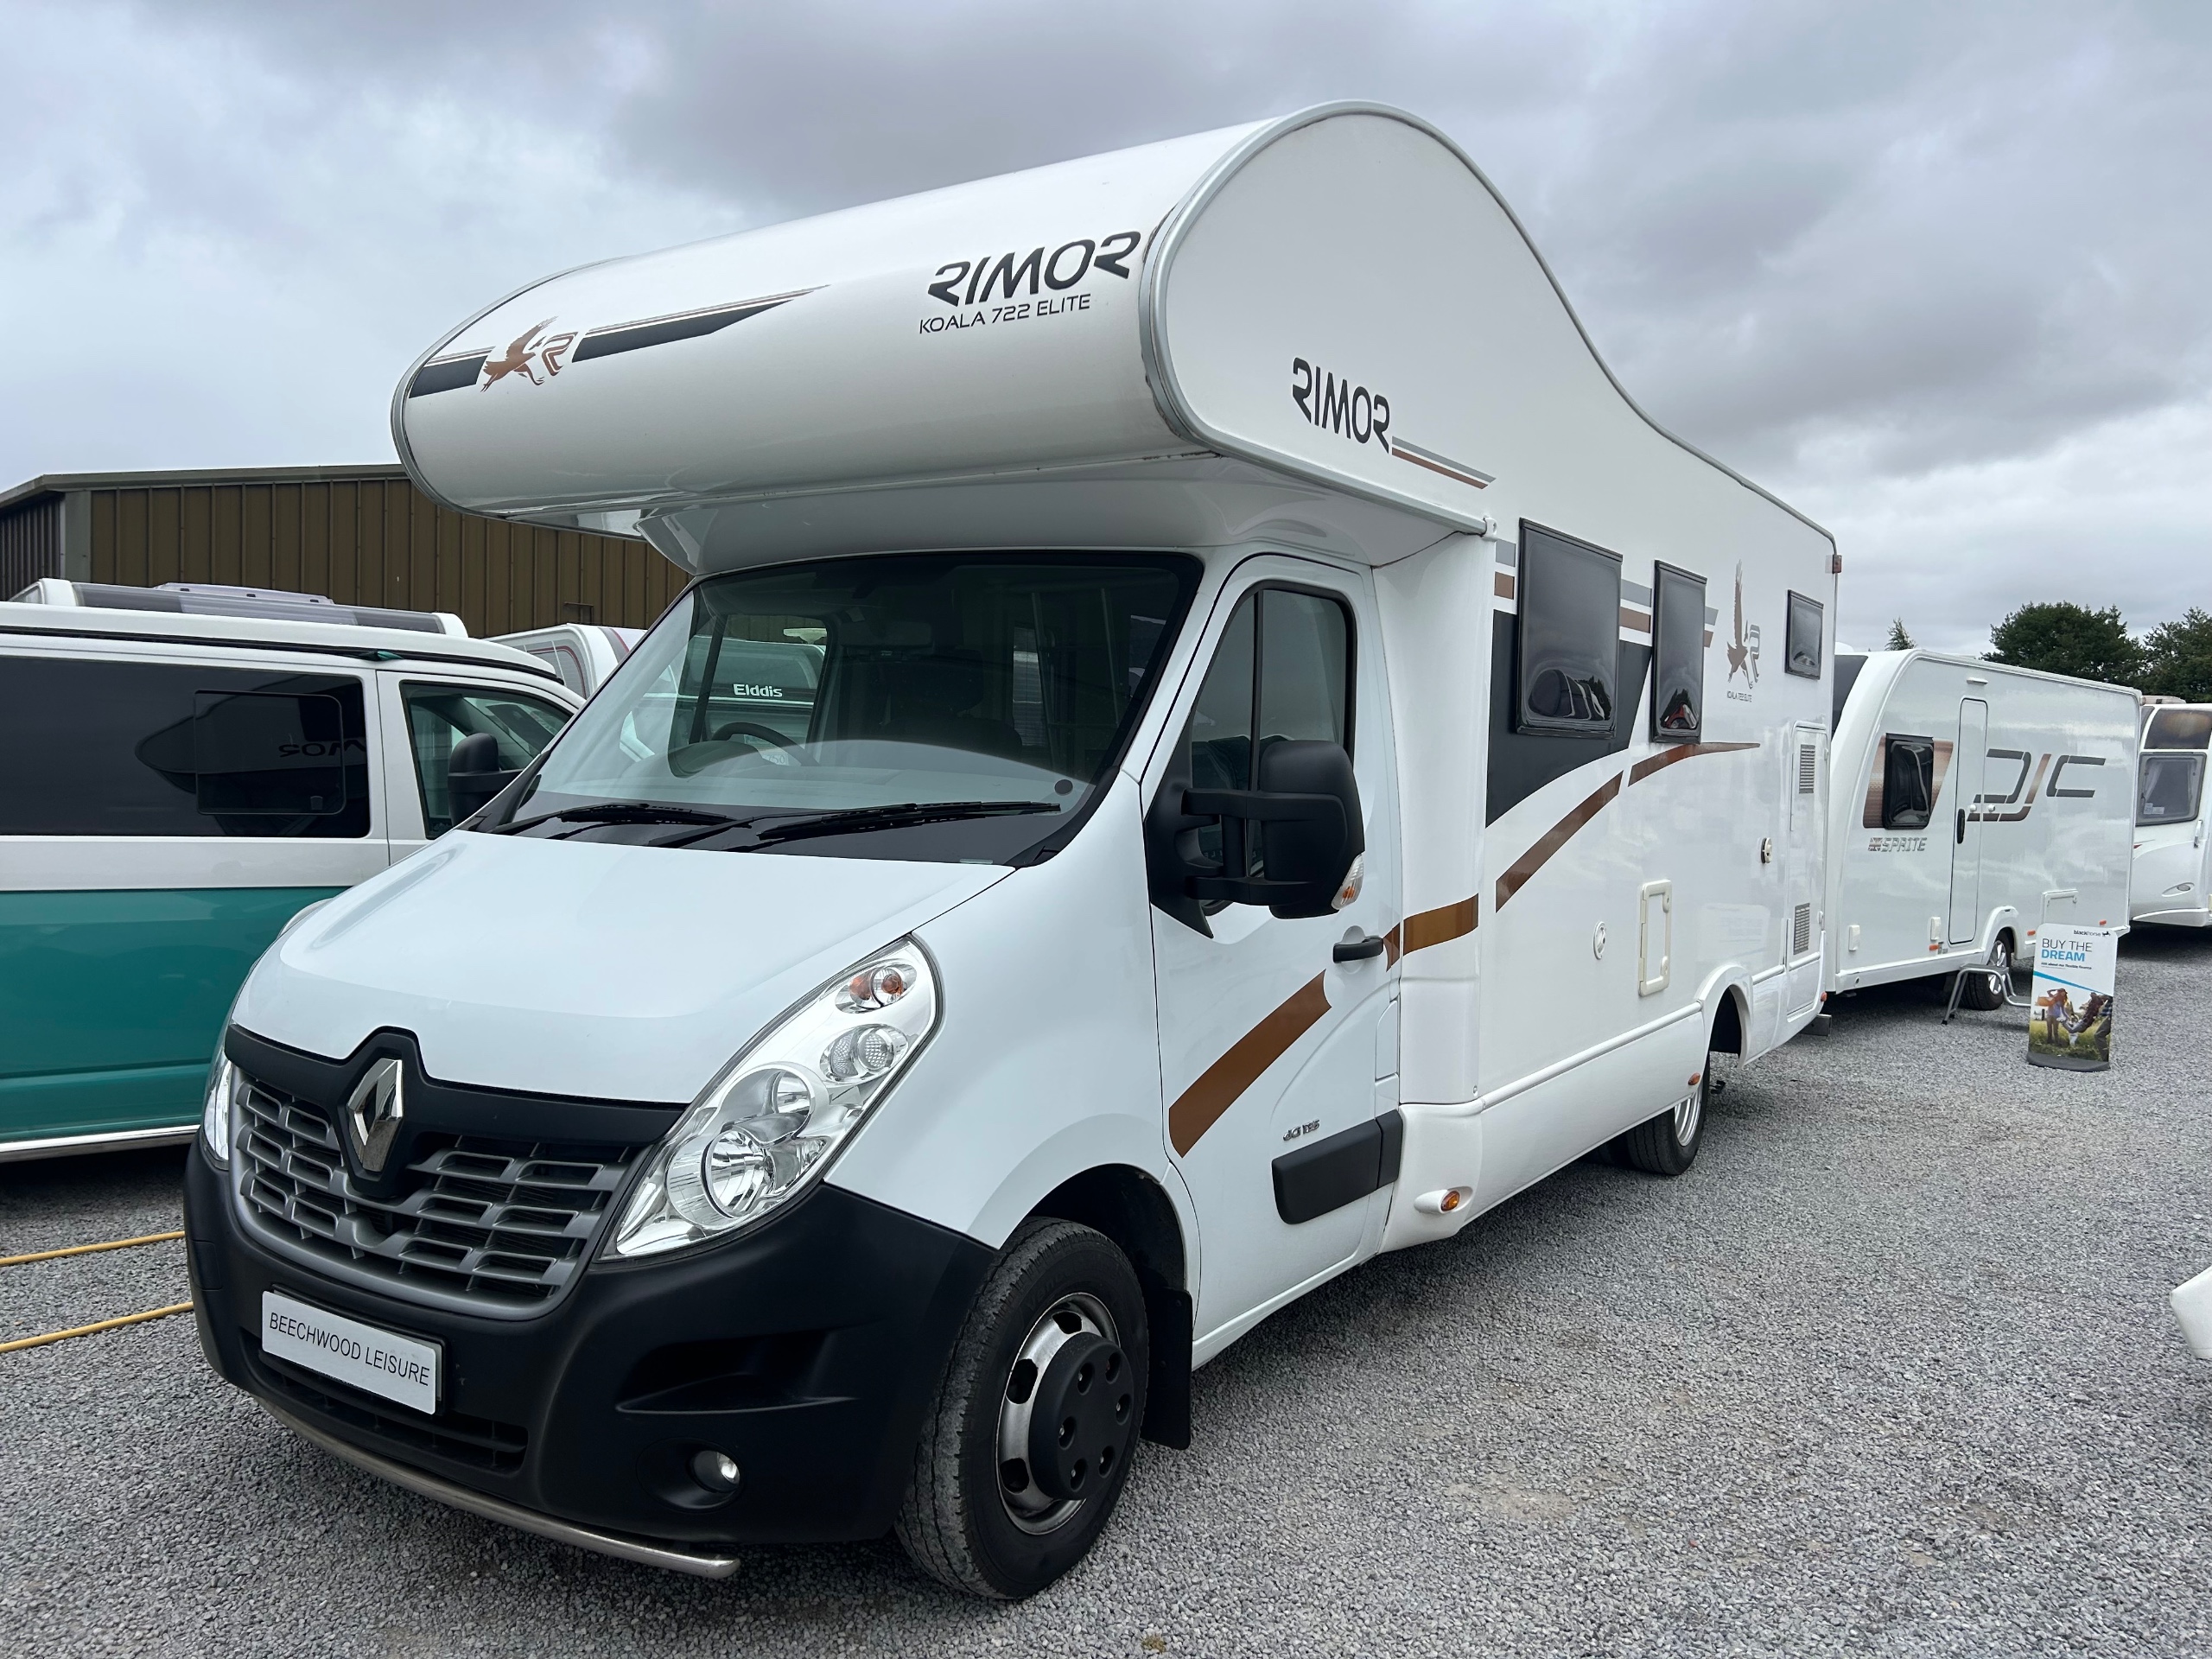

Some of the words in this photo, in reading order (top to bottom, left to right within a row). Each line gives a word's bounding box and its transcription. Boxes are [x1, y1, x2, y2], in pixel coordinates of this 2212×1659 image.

[928, 231, 1141, 307] RIMOR
[919, 311, 986, 334] KOALA
[992, 304, 1030, 324] 722
[1037, 294, 1090, 316] ELITE
[1293, 357, 1389, 454] RIMOR
[734, 683, 783, 697] Elddis
[1881, 837, 1927, 852] SPRITE
[2041, 949, 2085, 962] DREAM
[2042, 938, 2066, 950] BUY
[2069, 941, 2093, 952] THE
[270, 1312, 361, 1360] BEECHWOOD
[365, 1347, 430, 1386] LEISURE
